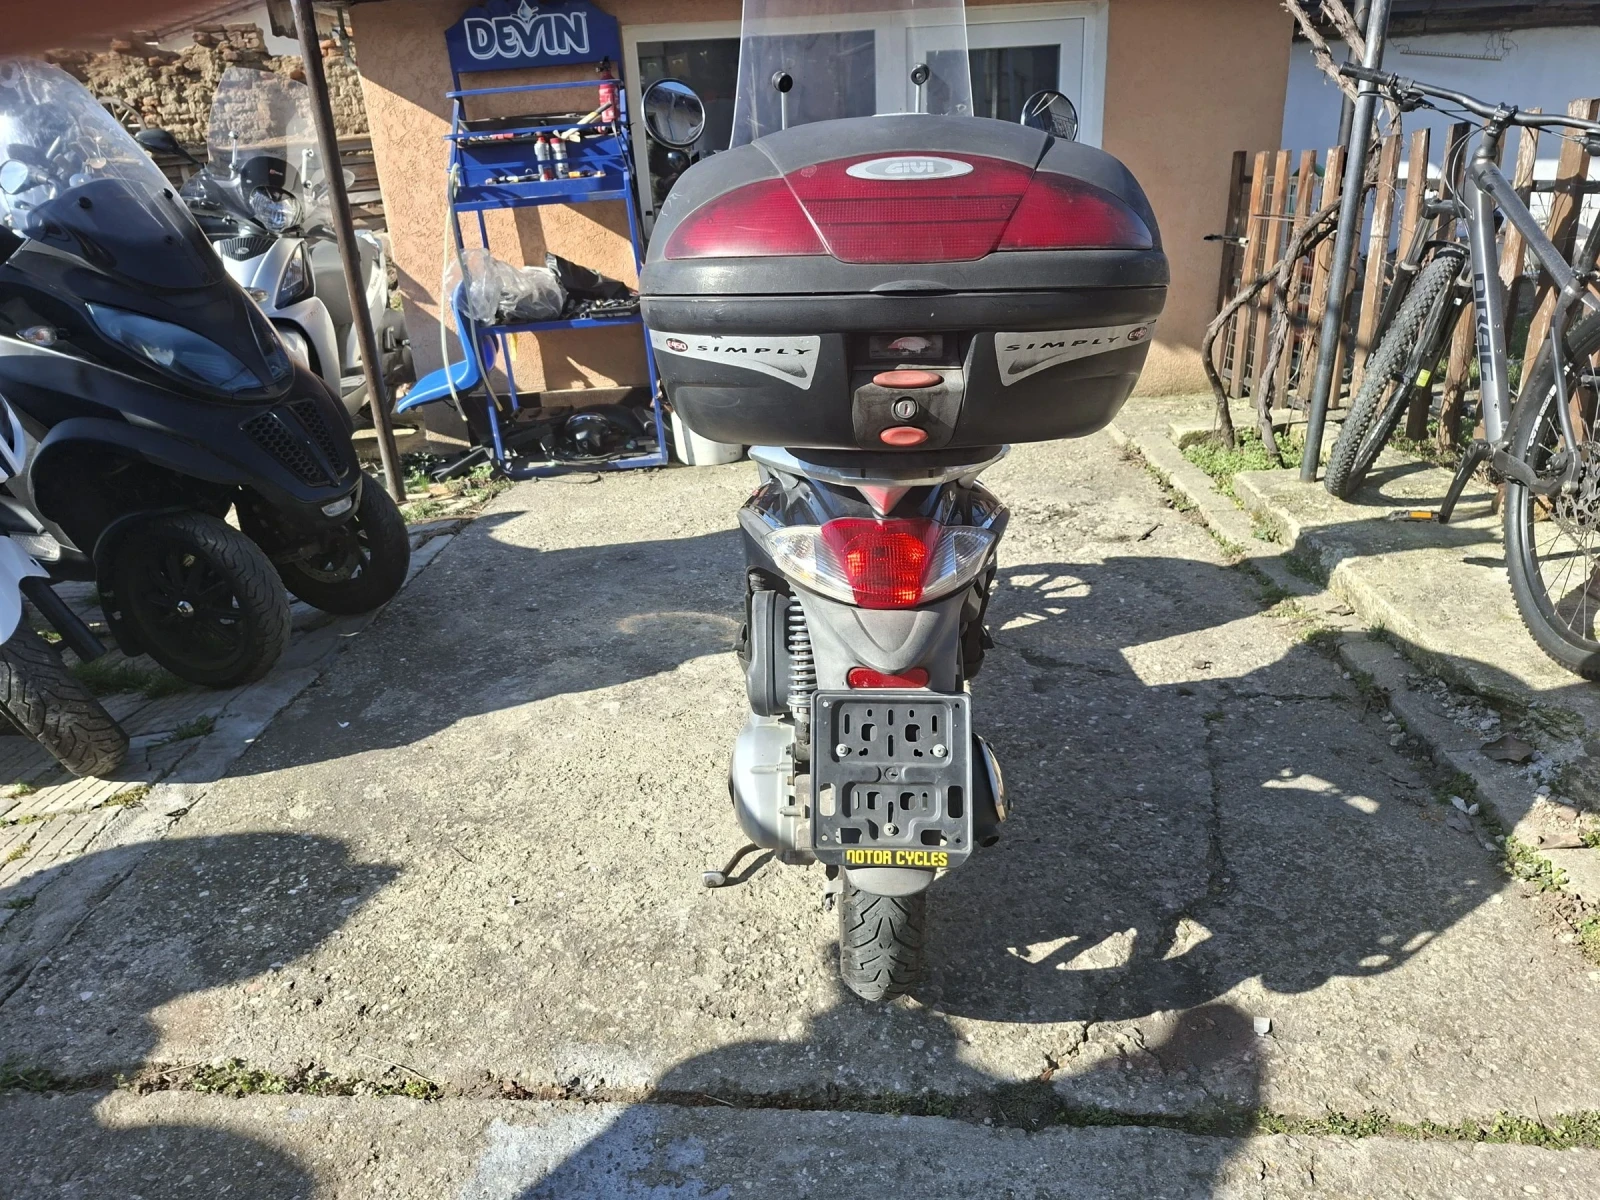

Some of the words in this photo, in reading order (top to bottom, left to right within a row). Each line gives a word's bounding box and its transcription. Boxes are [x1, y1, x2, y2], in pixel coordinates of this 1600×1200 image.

[464, 12, 590, 60] DEVIN
[884, 161, 935, 174] GIVI
[1474, 273, 1494, 381] DRAG
[697, 345, 813, 355] SIMPLY
[1004, 336, 1121, 351] SIMPLY
[896, 850, 948, 867] CYCLES
